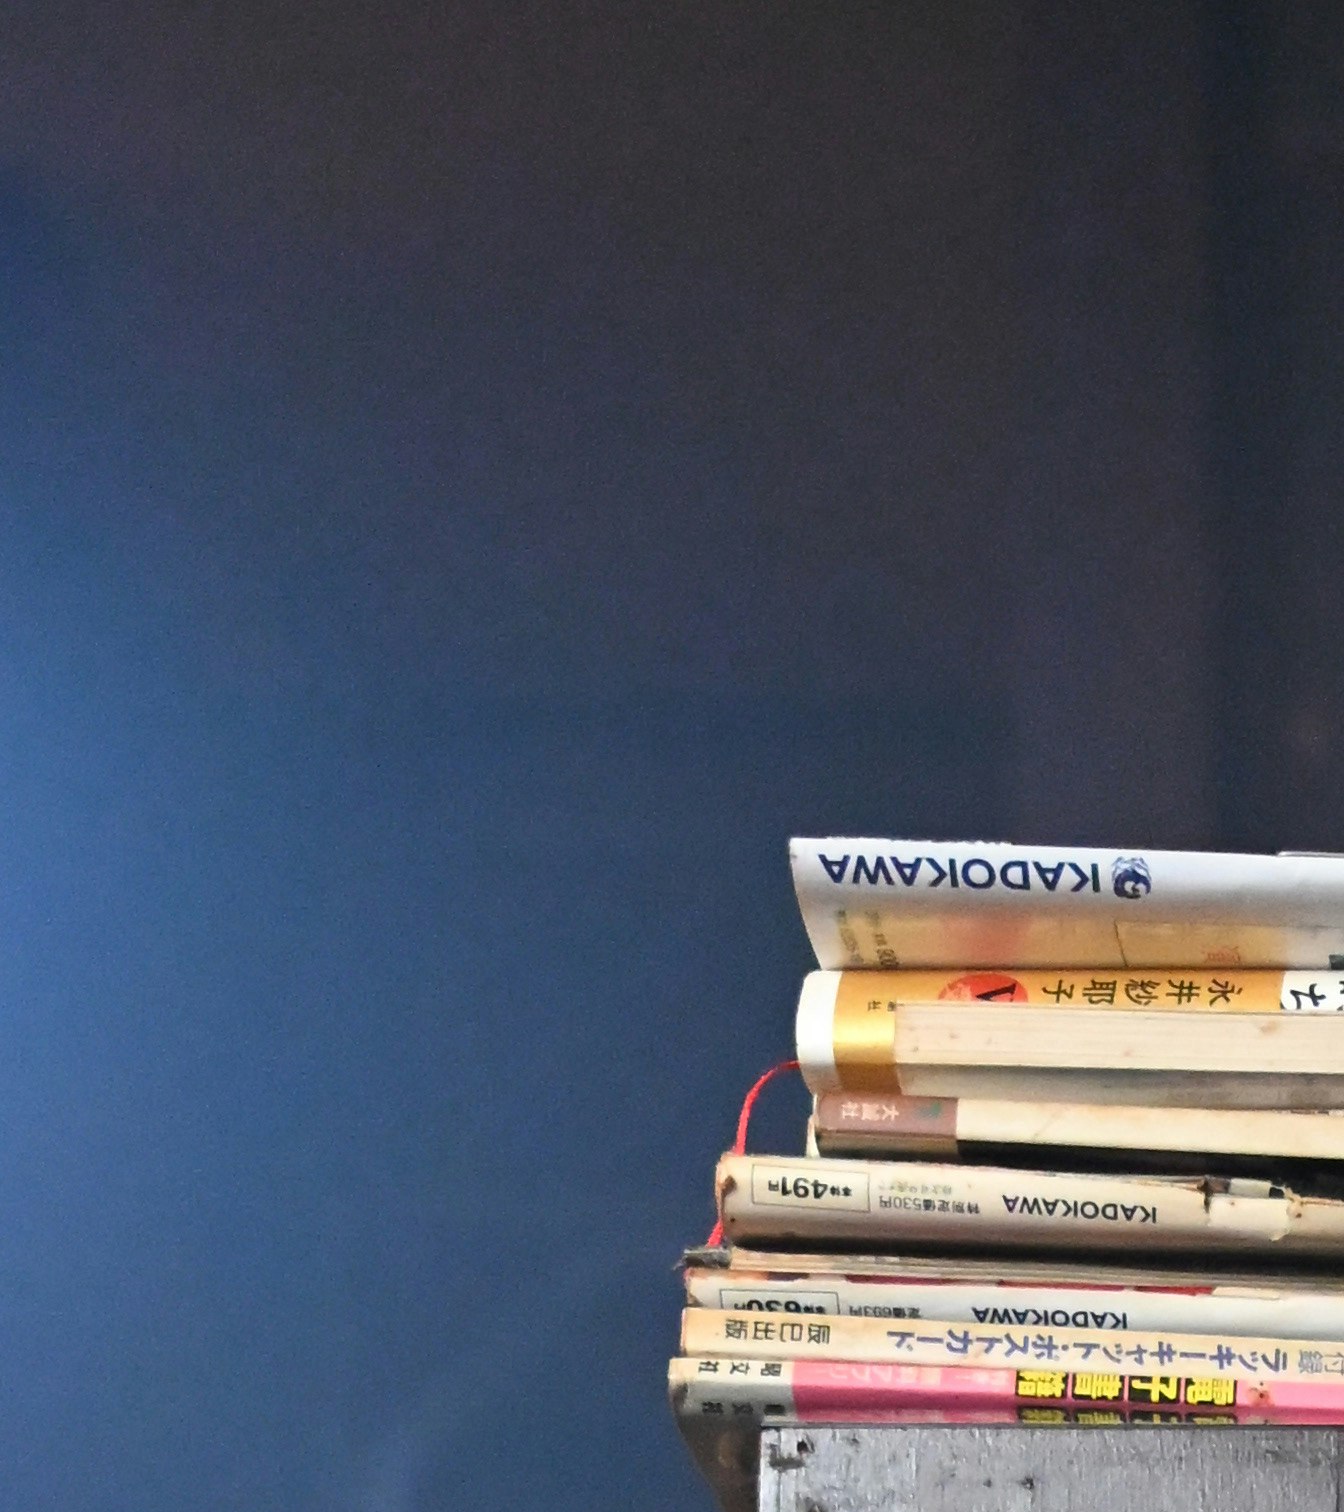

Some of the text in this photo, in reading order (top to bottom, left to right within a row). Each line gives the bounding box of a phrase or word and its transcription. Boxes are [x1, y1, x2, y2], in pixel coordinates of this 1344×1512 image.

[818, 854, 1099, 894] KADOKAWA
[1042, 979, 1243, 1007] 永井紗耶子
[878, 1195, 981, 1215] 特別定価530円
[1001, 1194, 1157, 1224] KADOKAWA
[971, 1306, 1128, 1331] KADOKAWA
